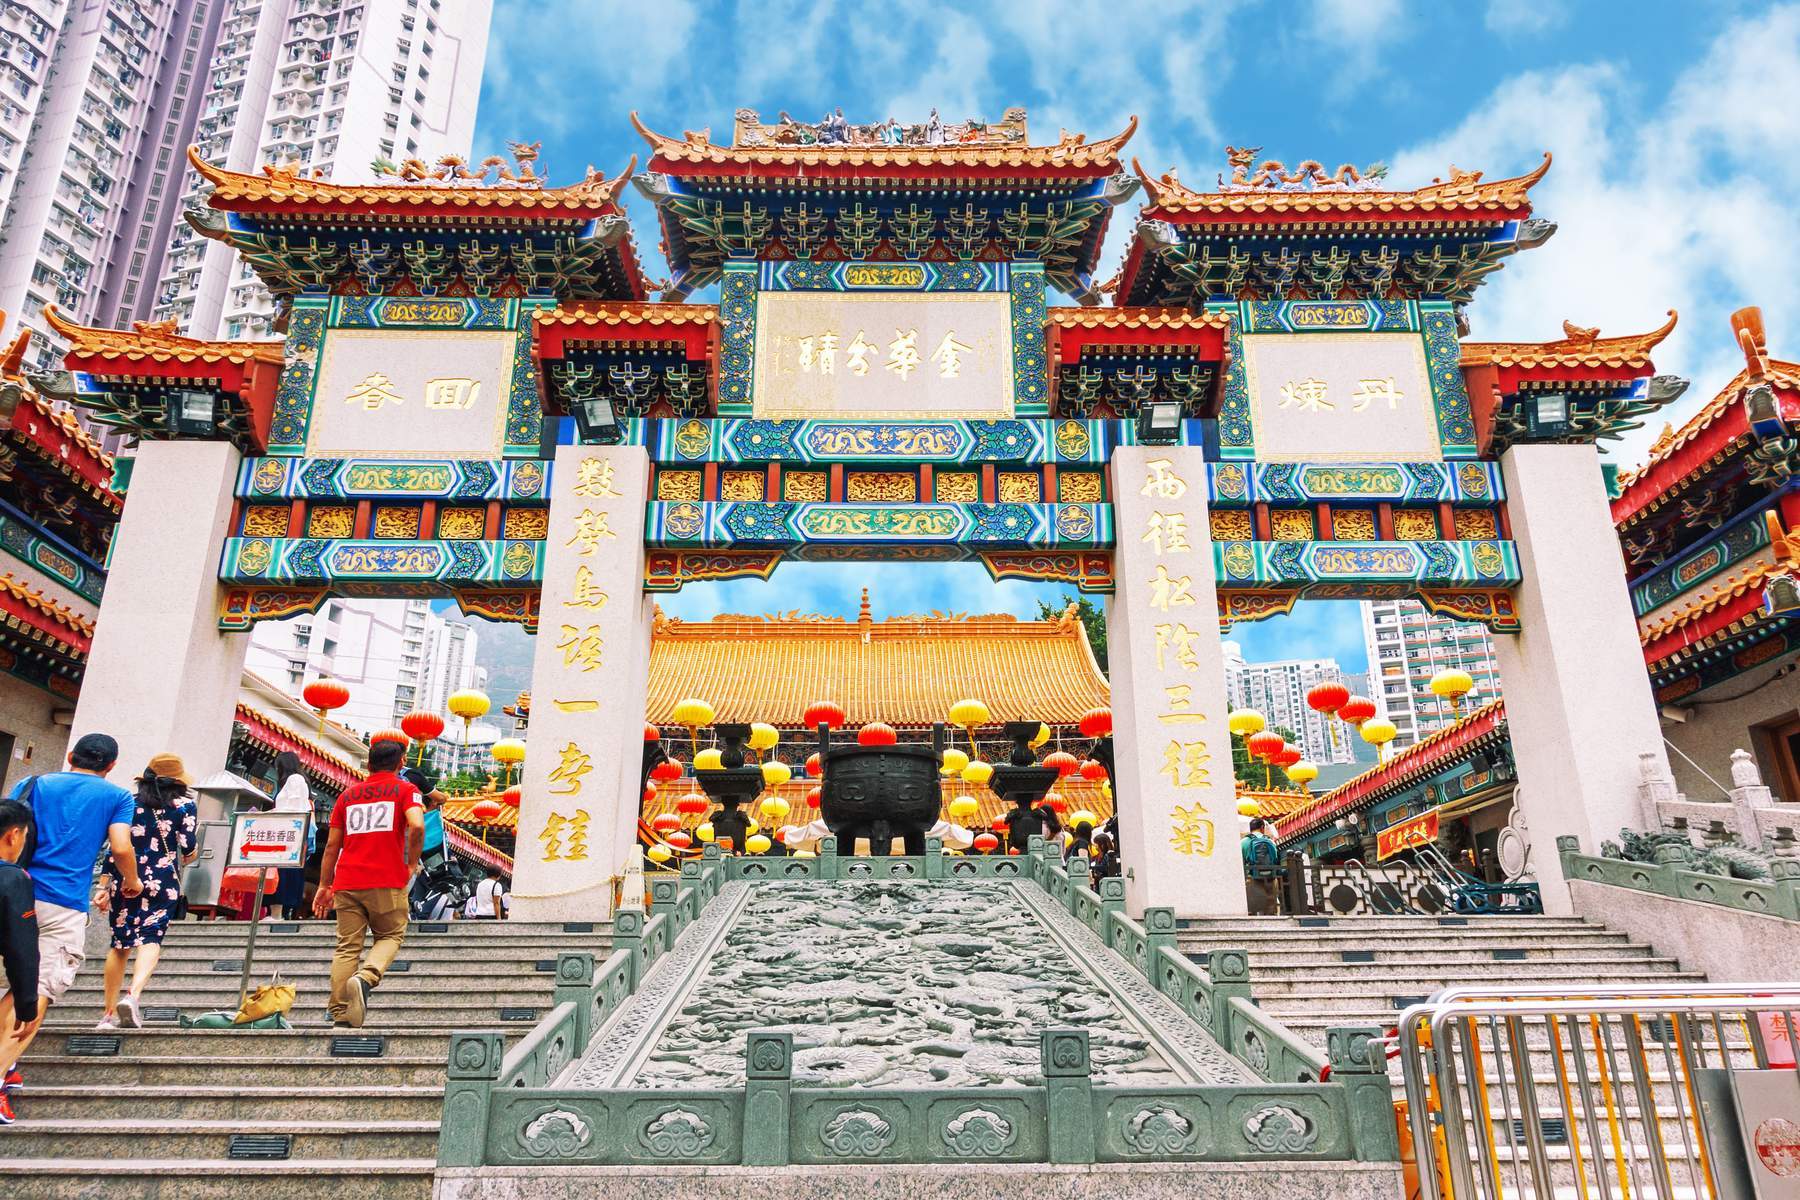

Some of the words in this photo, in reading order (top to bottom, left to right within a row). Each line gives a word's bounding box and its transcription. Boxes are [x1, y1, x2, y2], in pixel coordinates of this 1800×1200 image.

[349, 803, 389, 831] 012
[245, 830, 297, 843] 先往點香區
